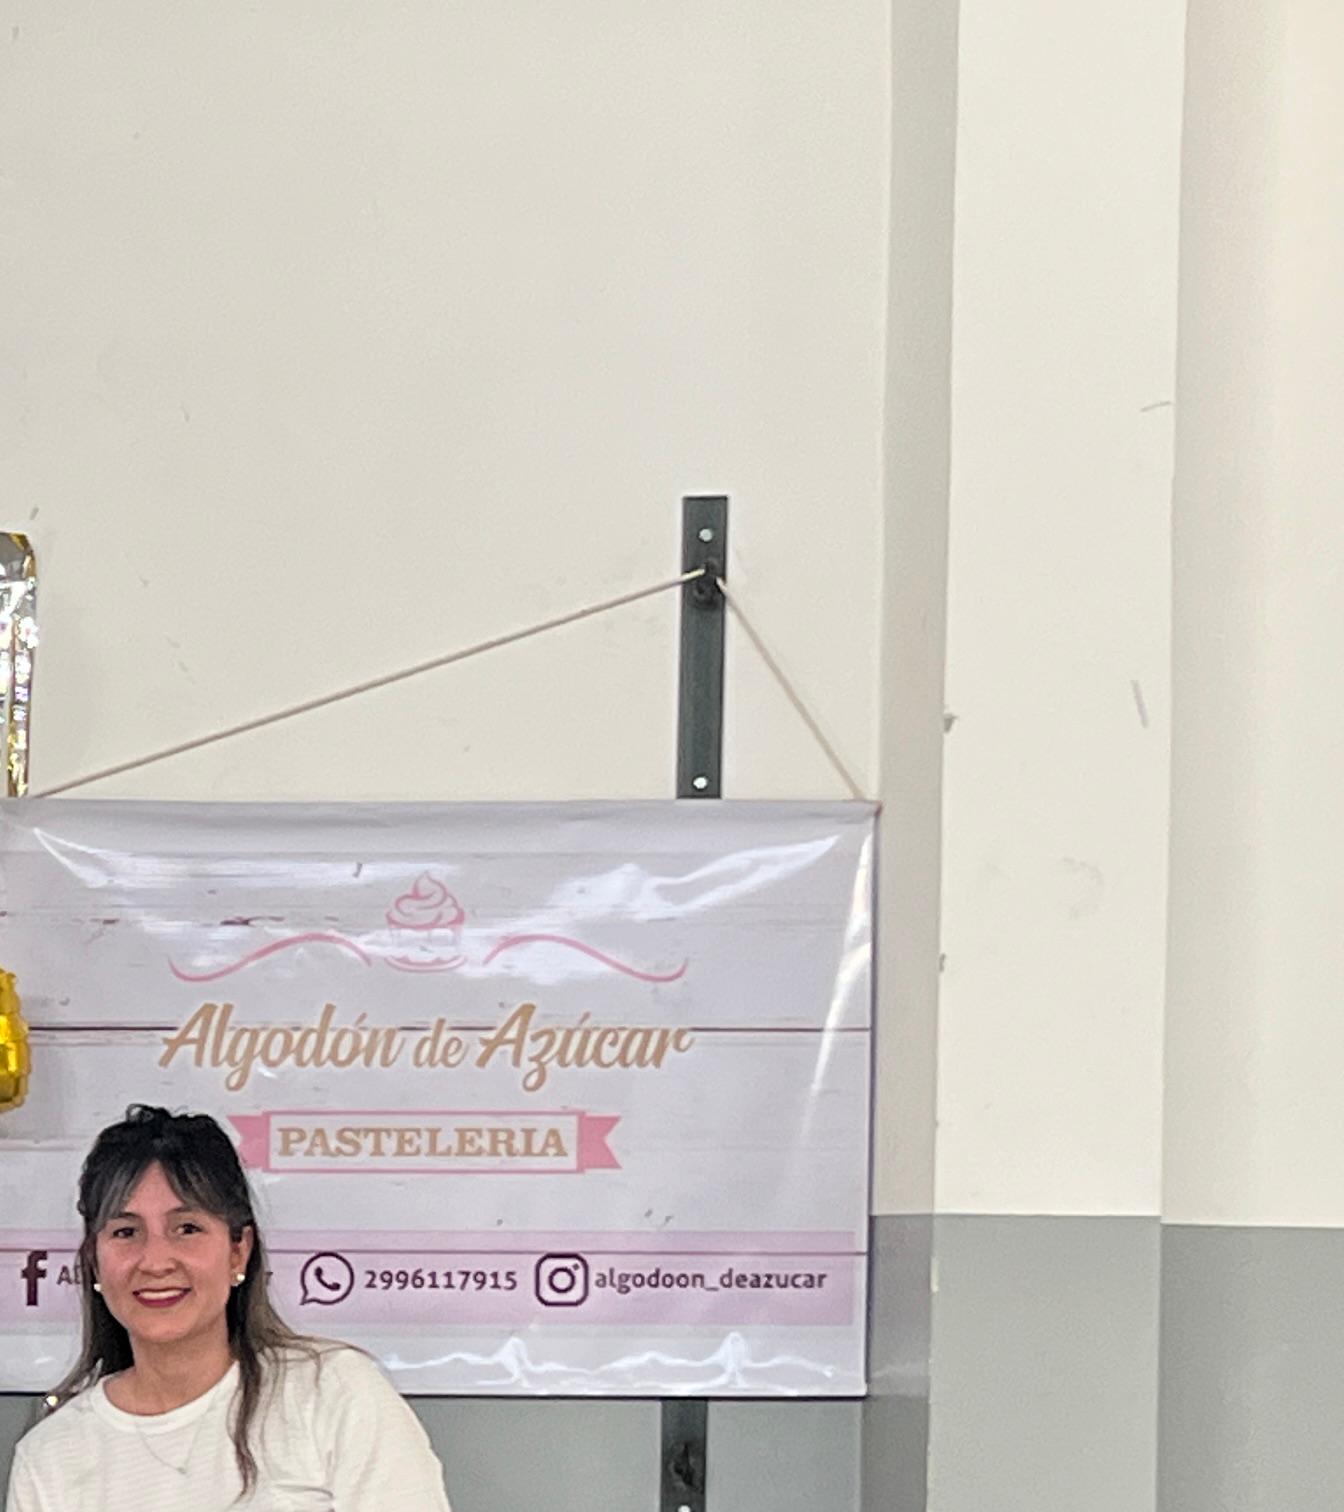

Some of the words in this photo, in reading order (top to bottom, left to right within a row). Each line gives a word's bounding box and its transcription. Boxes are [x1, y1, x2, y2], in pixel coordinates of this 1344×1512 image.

[157, 1002, 404, 1092] Algodón
[413, 1018, 467, 1067] de
[474, 1002, 694, 1092] Azúcar
[276, 1127, 569, 1158] PASTELERIA
[363, 1269, 518, 1291] 2996117915
[594, 1268, 828, 1295] algodoon_deazucar
